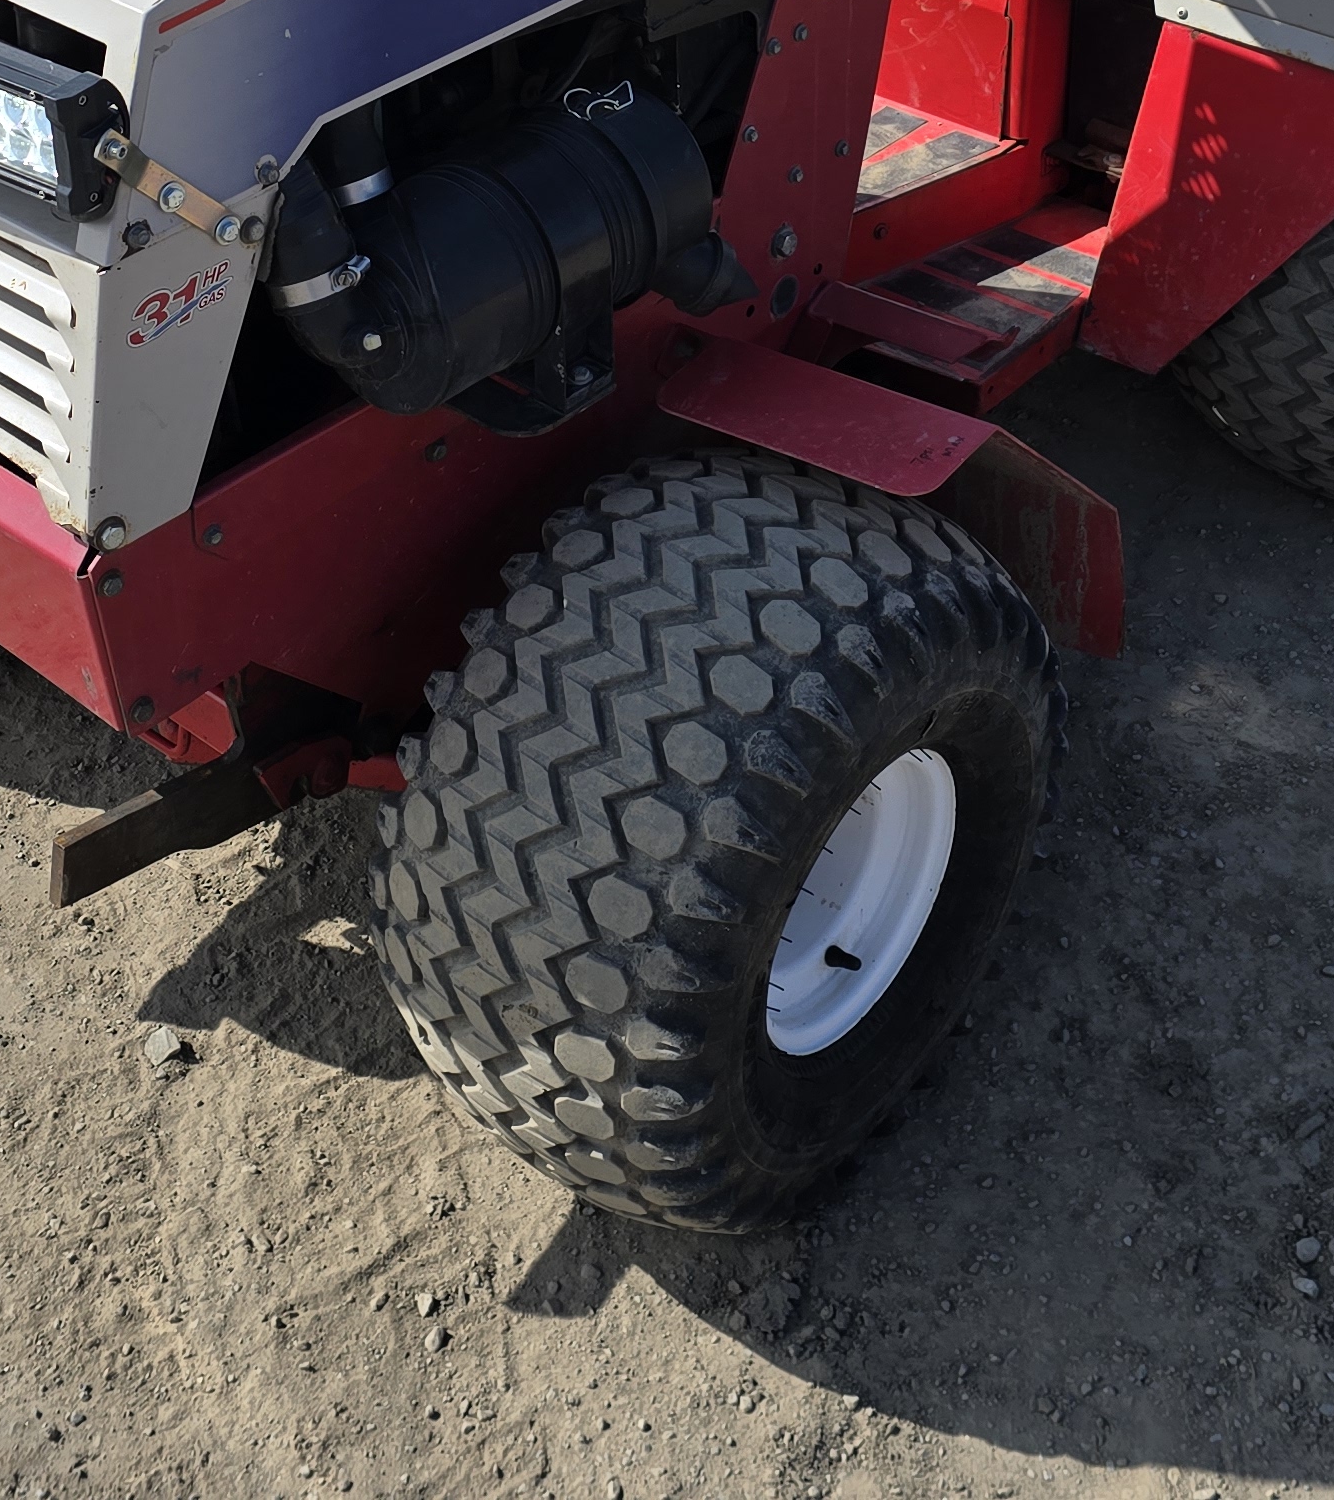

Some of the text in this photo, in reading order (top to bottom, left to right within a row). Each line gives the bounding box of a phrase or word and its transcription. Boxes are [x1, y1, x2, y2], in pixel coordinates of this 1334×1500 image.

[128, 260, 229, 347] 31 HP
[198, 287, 225, 310] GAS
